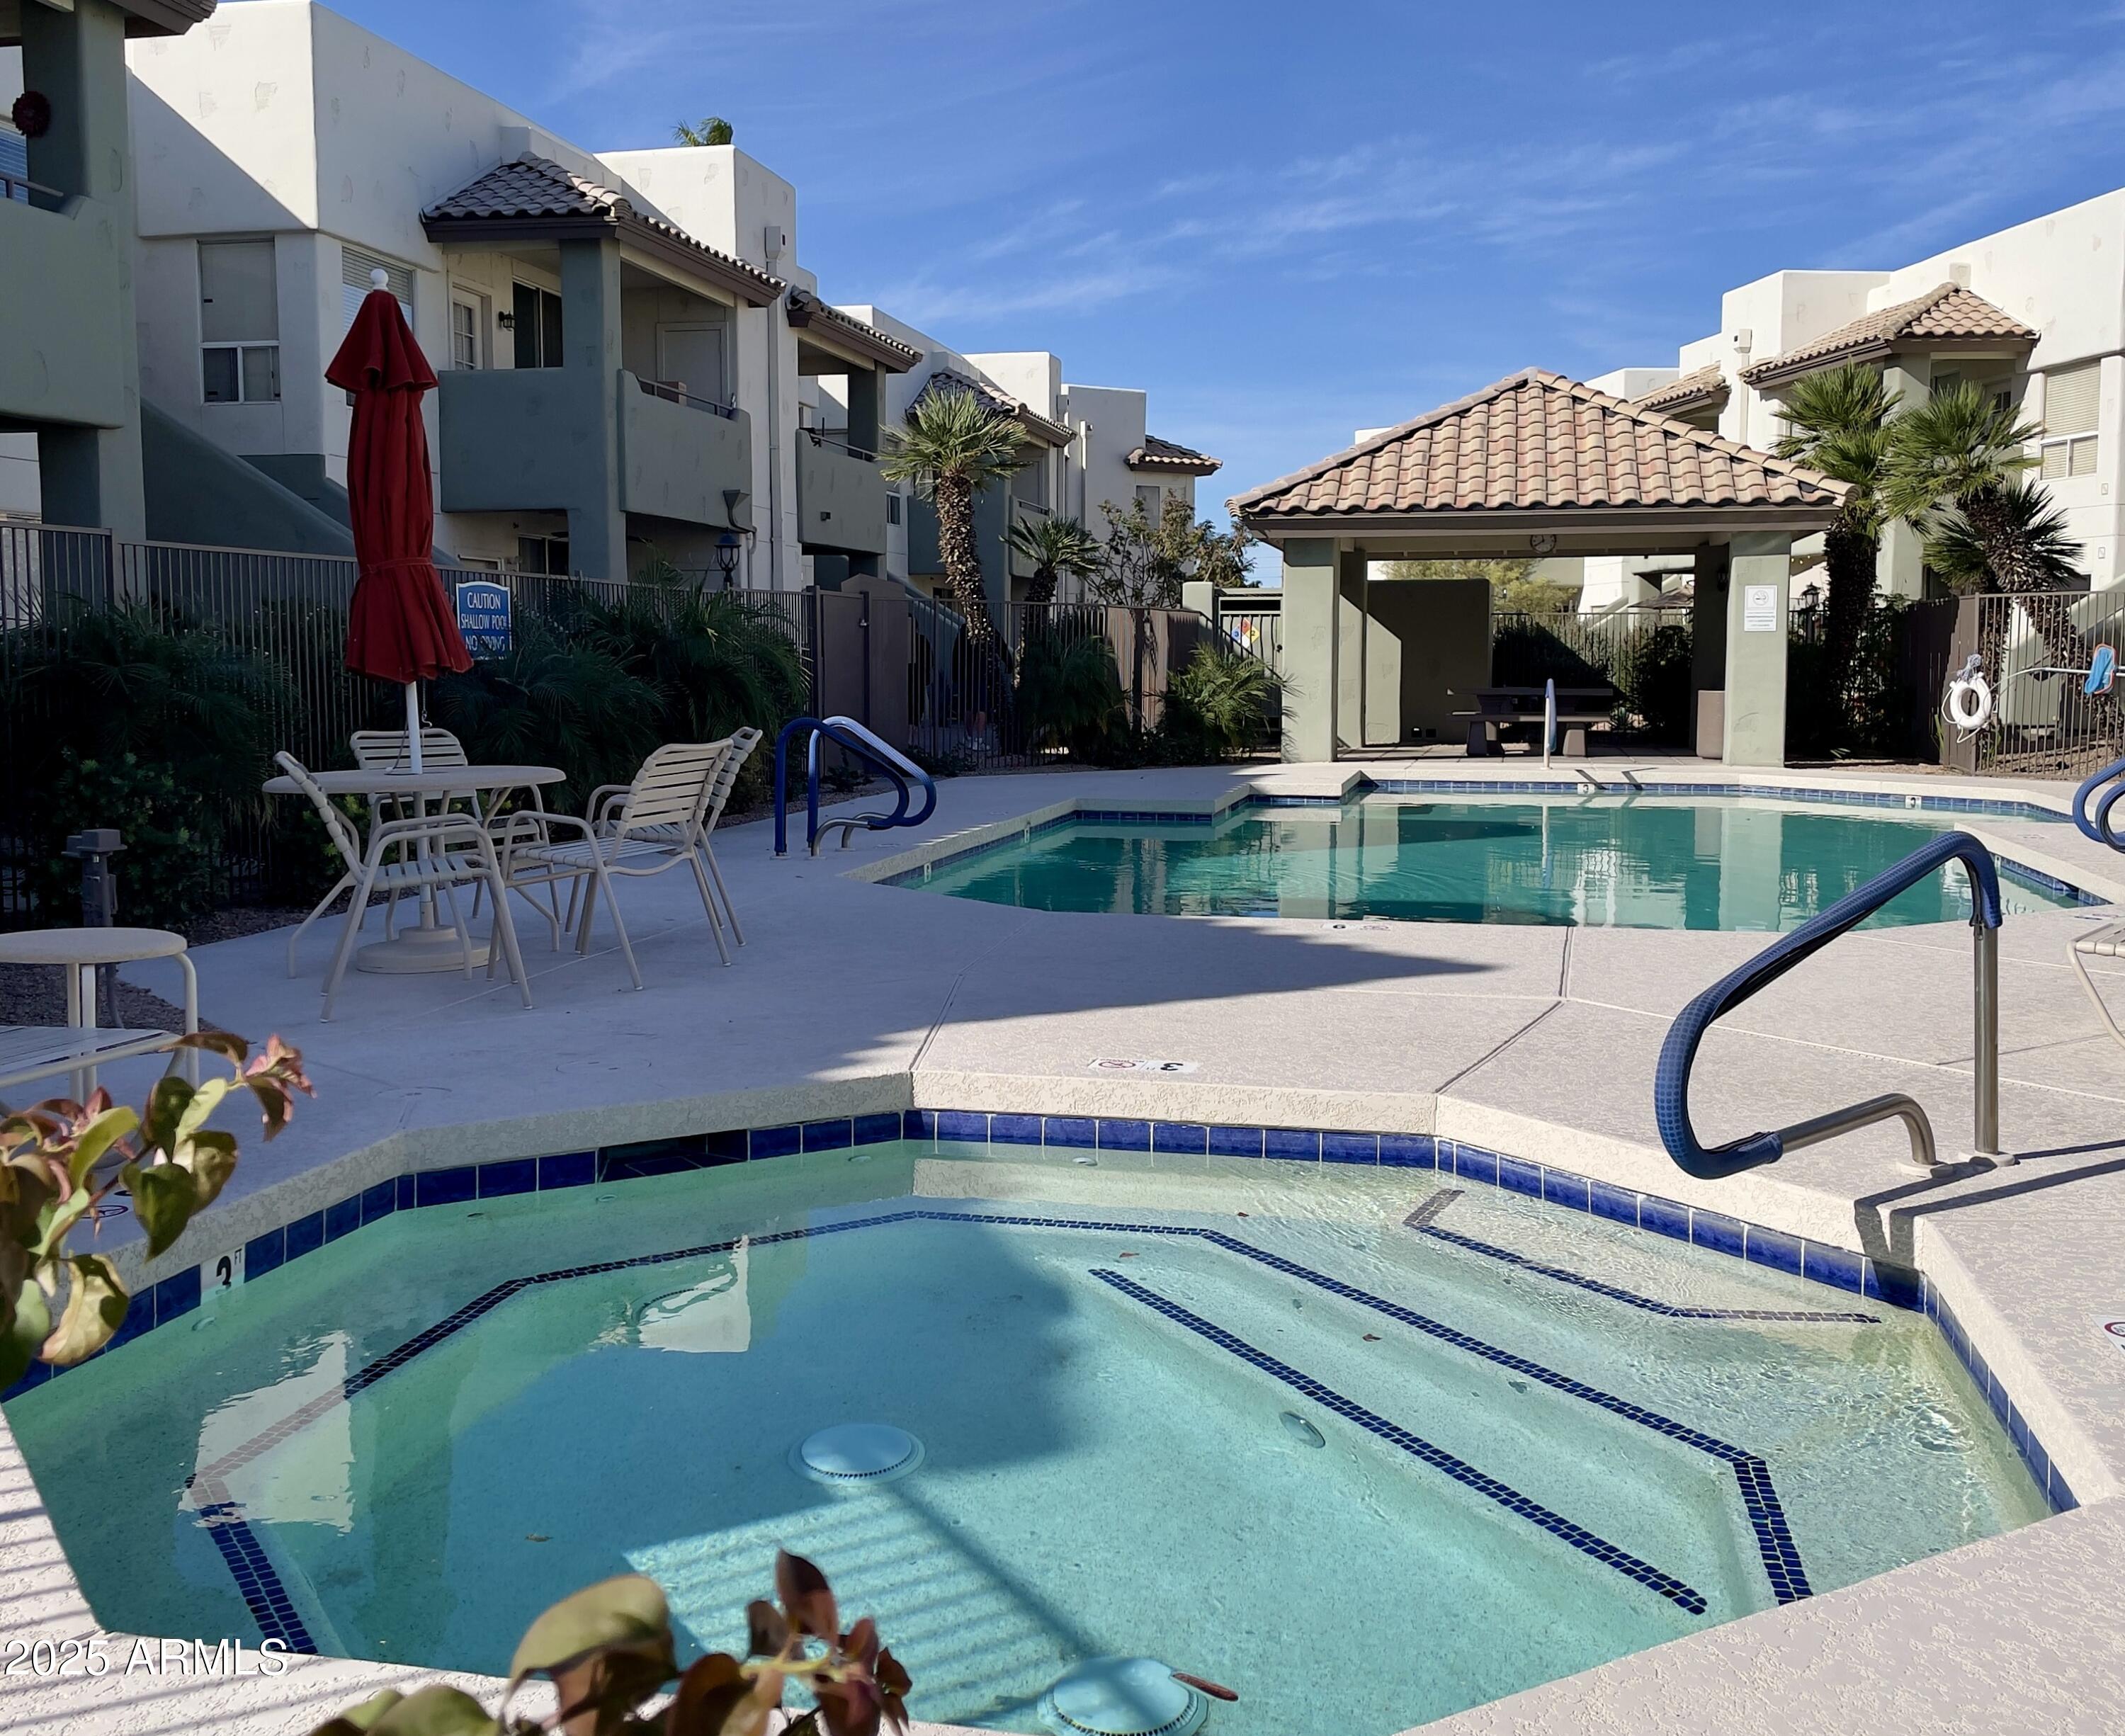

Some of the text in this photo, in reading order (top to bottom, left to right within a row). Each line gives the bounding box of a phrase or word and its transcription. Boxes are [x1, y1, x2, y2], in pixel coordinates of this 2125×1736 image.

[468, 592, 501, 609] CAUTION
[461, 613, 509, 630] SHALLOW POOL
[465, 635, 477, 651] NO
[1160, 1062, 1184, 1071] 3
[234, 1248, 242, 1266] FT
